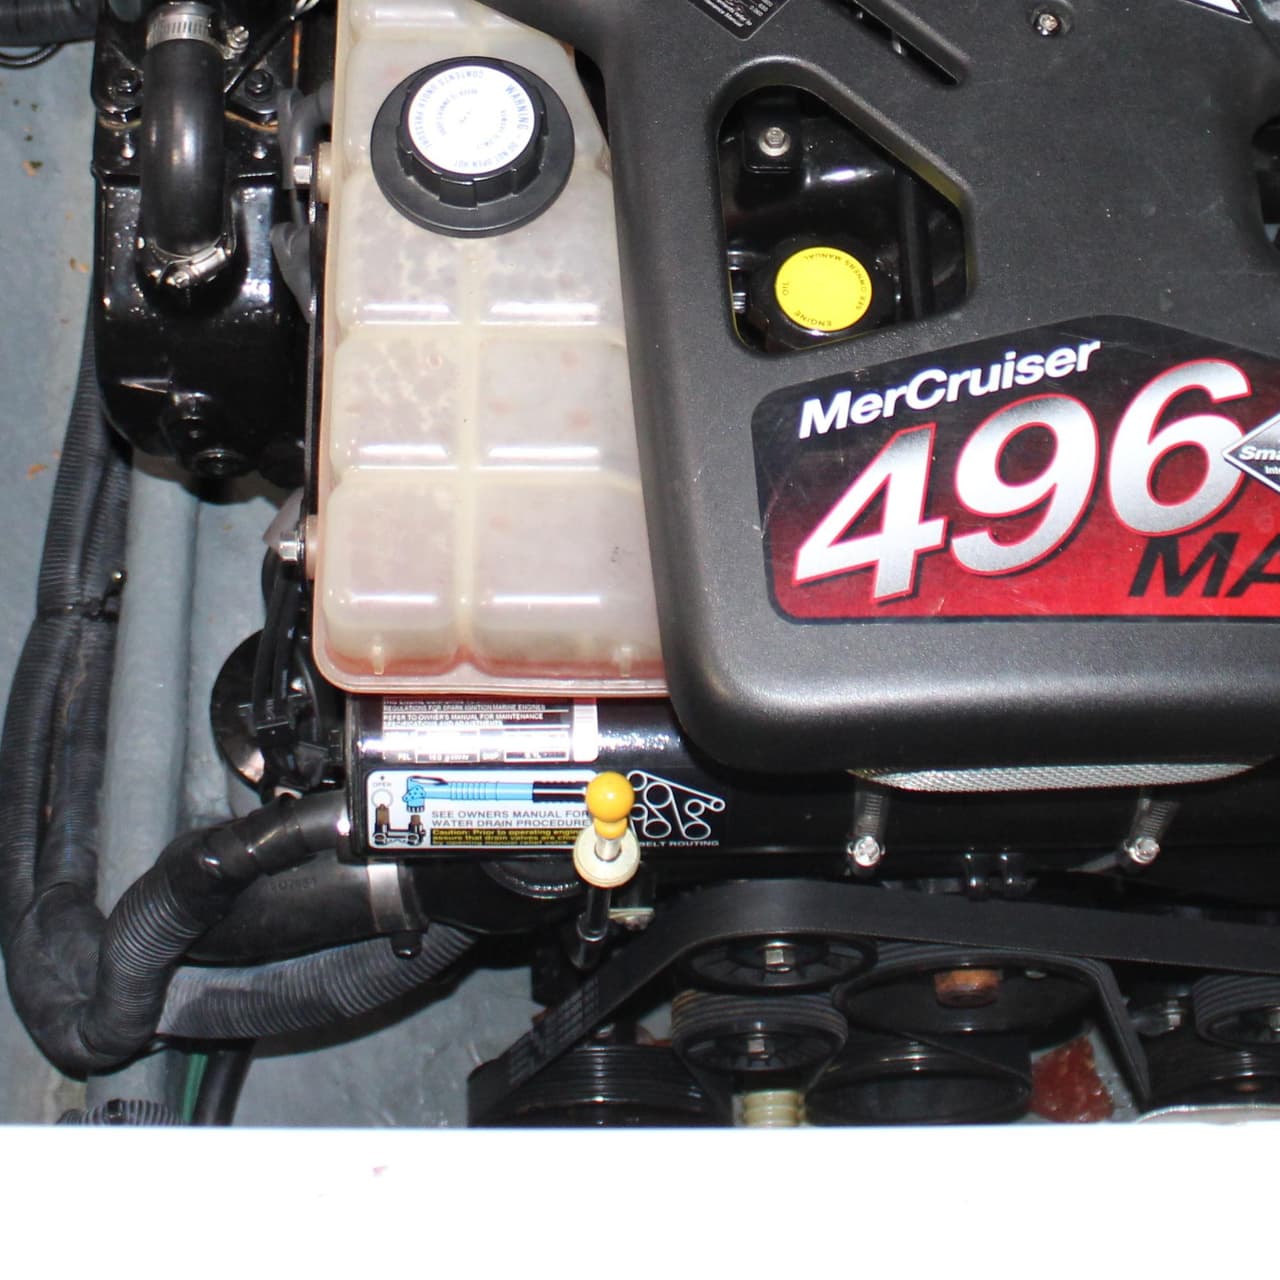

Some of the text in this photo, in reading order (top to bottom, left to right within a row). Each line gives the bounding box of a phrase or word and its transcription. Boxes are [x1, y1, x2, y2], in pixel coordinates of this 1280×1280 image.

[438, 69, 485, 86] CONTENTS
[505, 84, 529, 130] WARNING
[803, 252, 841, 262] MANUAL
[845, 260, 867, 292] OWNERS
[782, 281, 833, 327] ENGINE OIL
[797, 338, 1103, 440] MerCruiser
[793, 358, 1252, 603] 496
[432, 810, 589, 819] SEE OWNERS MANUAL FOR
[432, 819, 473, 827] WATER
[477, 819, 512, 827] DRAIN
[433, 829, 470, 837] Caution:
[473, 829, 495, 837] Prior
[497, 829, 507, 837] to
[508, 829, 551, 837] operating
